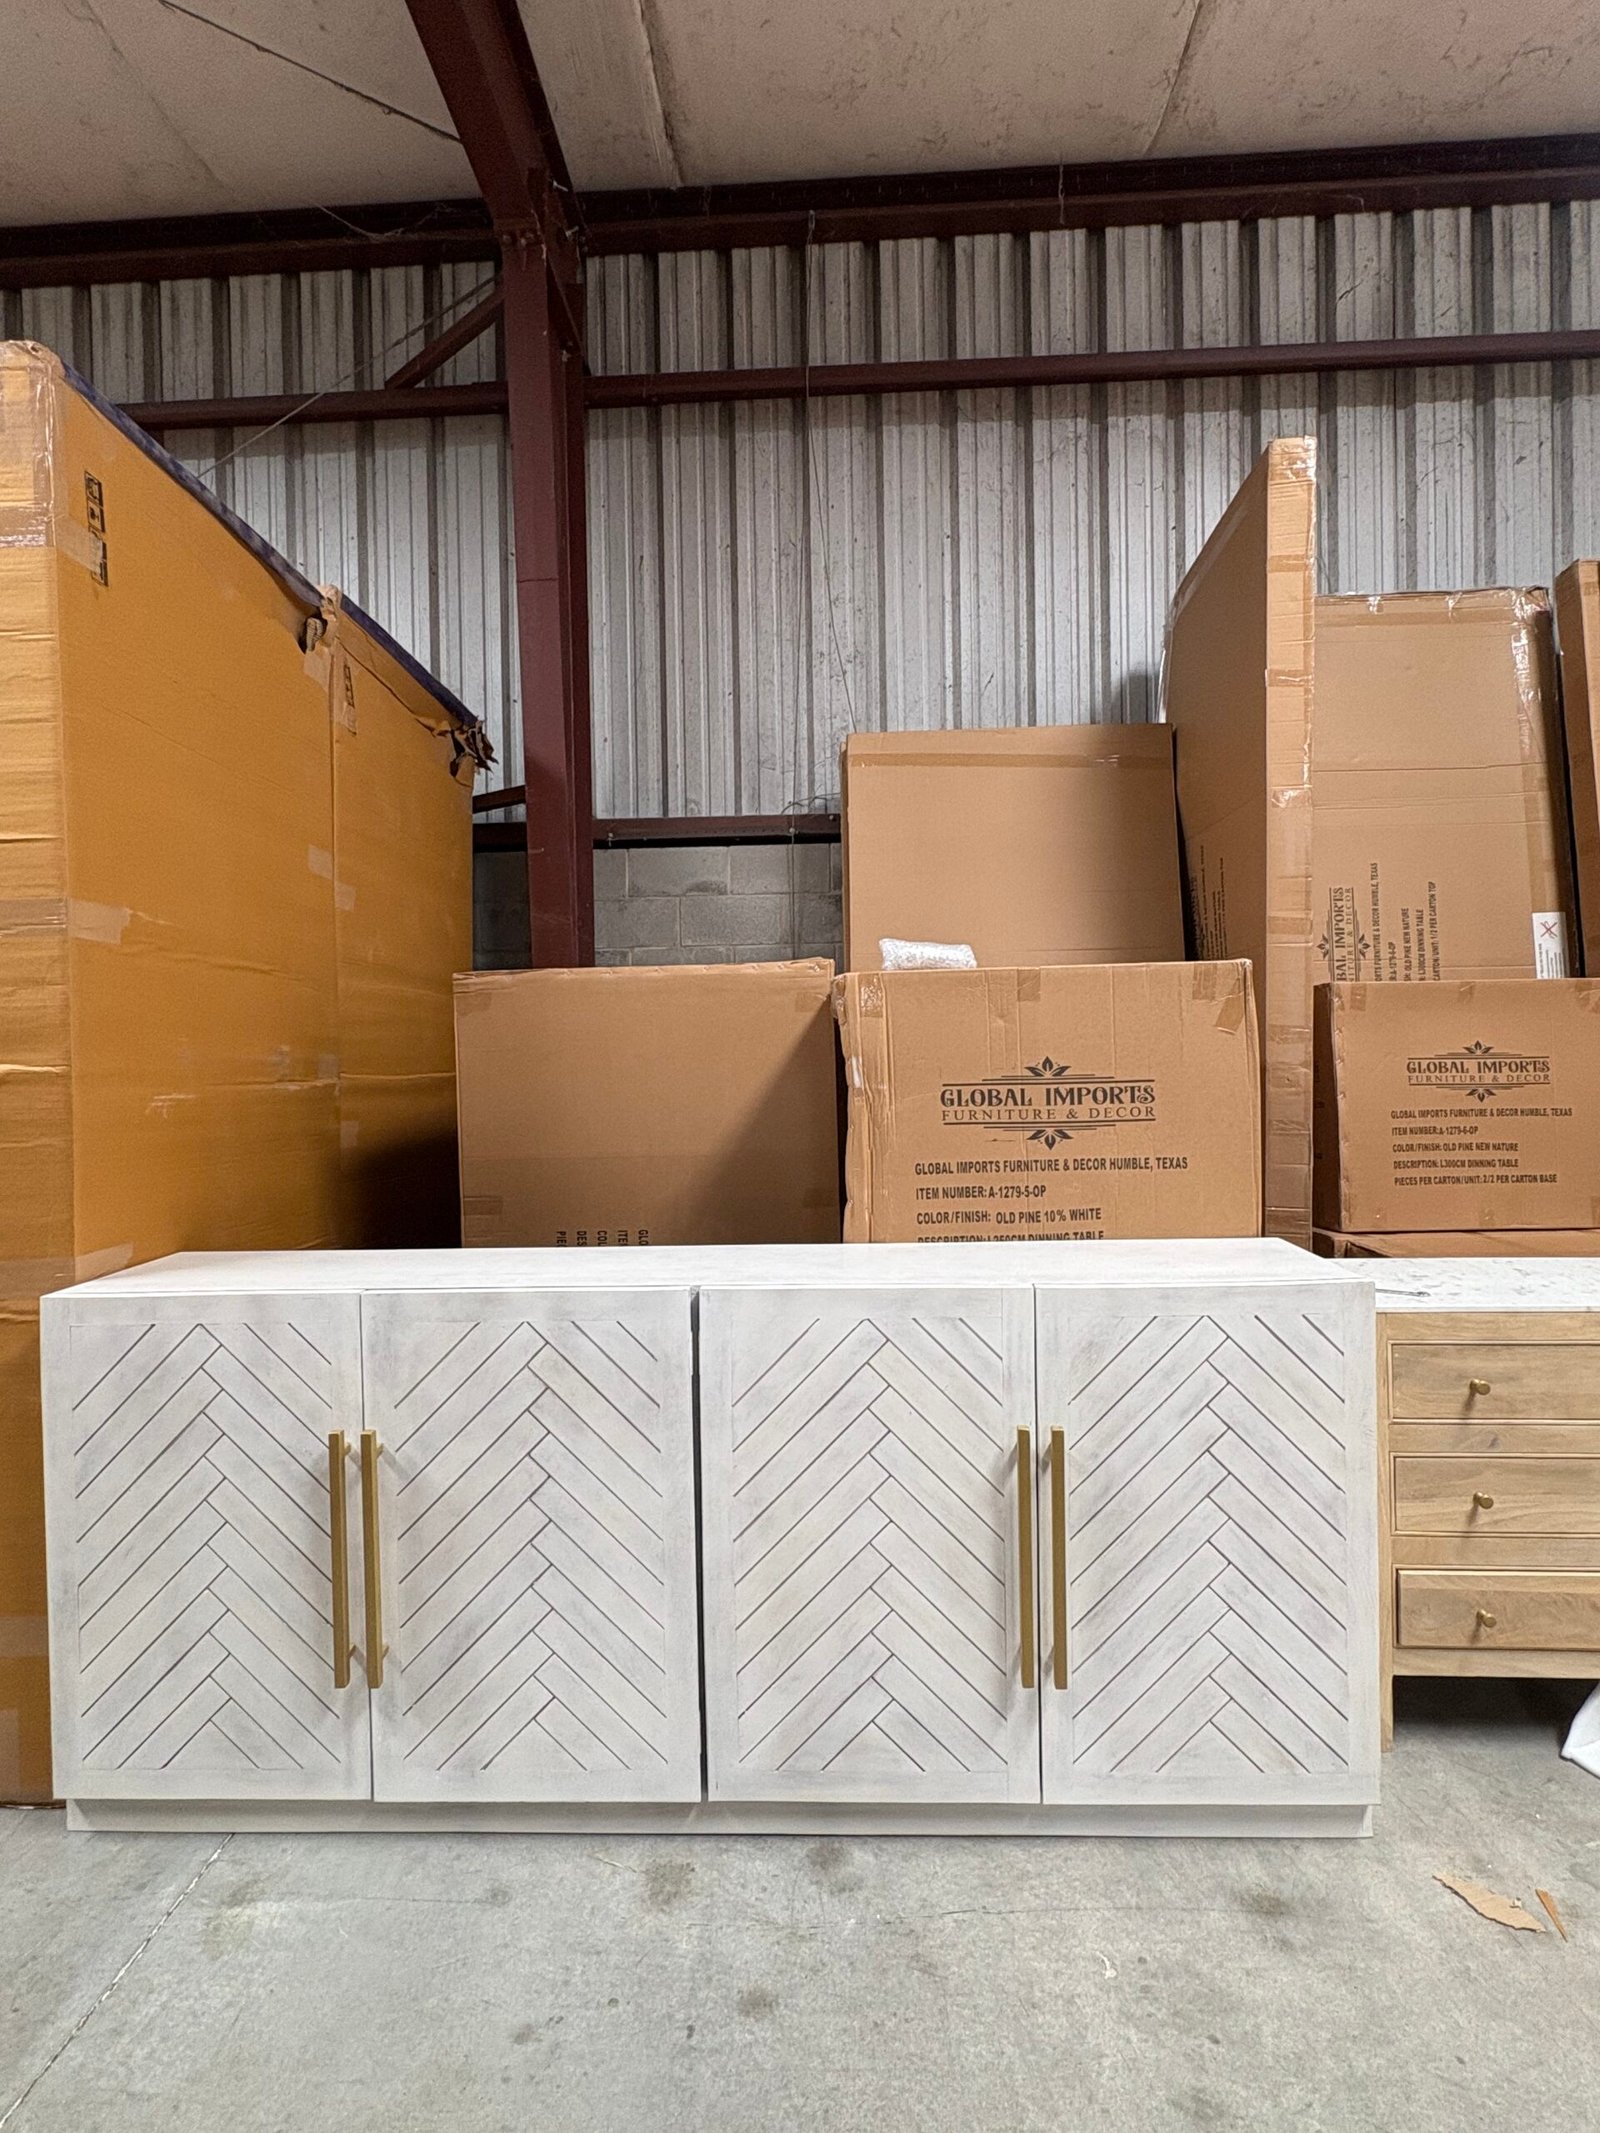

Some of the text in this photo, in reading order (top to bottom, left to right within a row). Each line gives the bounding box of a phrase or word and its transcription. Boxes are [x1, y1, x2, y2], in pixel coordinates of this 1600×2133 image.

[1370, 863, 1378, 880] TEXAS
[1428, 882, 1436, 892] TOP
[1333, 887, 1345, 948] IMPORTS
[1401, 908, 1410, 930] NATURE
[1416, 909, 1424, 927] TABLE
[1373, 934, 1381, 965] FURNITURE
[1404, 960, 1412, 971] OLD
[1407, 1060, 1550, 1074] GLOBAL IMPORTS
[1408, 1075, 1482, 1083] FURNITURE
[1507, 1074, 1550, 1082] DECOR
[941, 1085, 1155, 1107] GLOBAL IMPORTS
[942, 1106, 1155, 1121] FURNITURE & DECOR
[1391, 1110, 1416, 1119] GLOBAL
[1418, 1109, 1448, 1118] IMPORTS
[1450, 1109, 1487, 1117] FURNITURE
[1489, 1109, 1495, 1117] &
[1496, 1108, 1519, 1116] DECOR
[1550, 1108, 1572, 1116] TEXAS
[1392, 1127, 1407, 1136] ITEM
[1443, 1143, 1456, 1151] OLD
[1458, 1142, 1473, 1151] PINE
[1476, 1142, 1490, 1151] NEW
[1492, 1142, 1518, 1151] NATURE
[915, 1157, 1188, 1175] GLOBAL IMPORTS FURNITURE & DECOR HUMBLE, TEXAS
[1394, 1160, 1439, 1169] DESCRIPTION:
[1468, 1159, 1496, 1168] DINNING
[1498, 1159, 1518, 1167] TABLE
[1395, 1177, 1418, 1185] PIECES
[1420, 1176, 1432, 1185] PER
[1496, 1175, 1508, 1183] PER
[1511, 1174, 1537, 1183] CARTON
[1540, 1174, 1557, 1182] BASE
[916, 1188, 939, 1200] ITEM
[917, 1208, 1101, 1224] COLOR/FINISH: OLD PINE 10% WHITE
